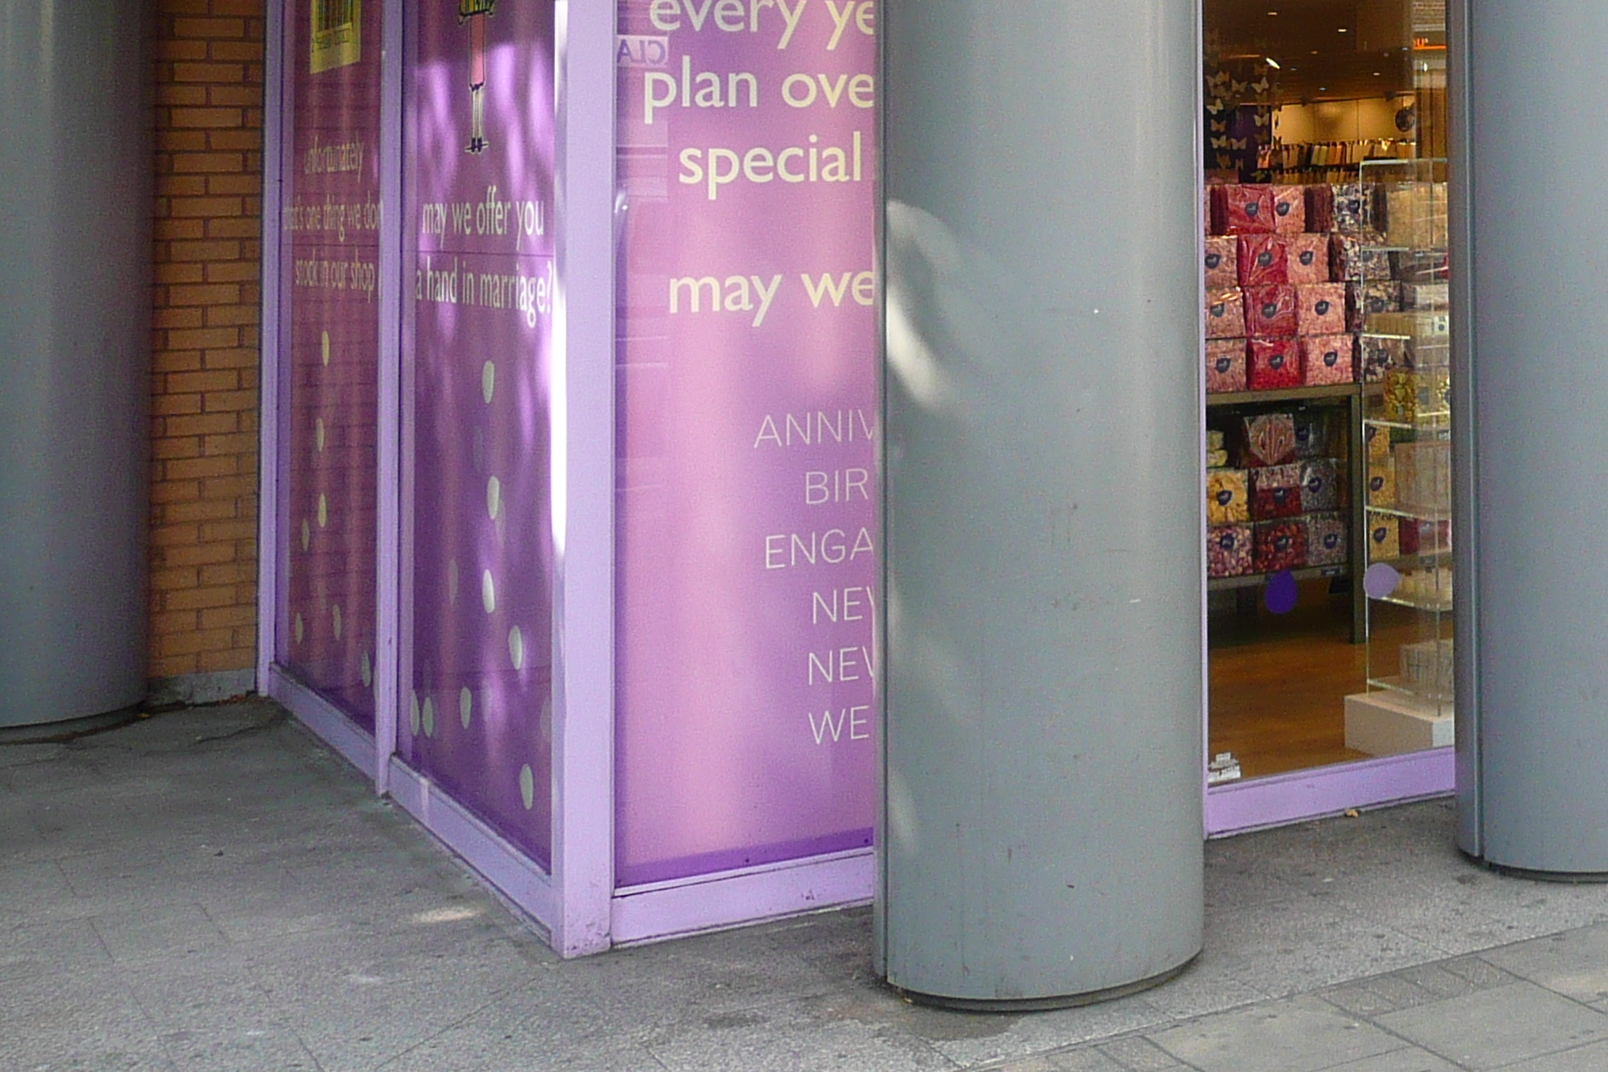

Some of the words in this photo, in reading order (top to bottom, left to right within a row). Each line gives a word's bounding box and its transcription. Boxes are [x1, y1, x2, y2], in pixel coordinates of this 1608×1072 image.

[644, 55, 757, 124] plan
[303, 129, 365, 183] unfortunately
[679, 131, 861, 200] special
[305, 204, 321, 230] one
[323, 192, 345, 242] thing
[422, 201, 448, 249] may
[453, 201, 471, 235] we
[476, 185, 512, 236] offer
[517, 199, 545, 251] you
[295, 248, 318, 286] stock
[331, 260, 349, 288] our
[350, 247, 376, 304] shop
[416, 268, 422, 300] a
[427, 256, 457, 303] hand
[463, 262, 474, 306] in
[481, 260, 554, 328] marriage?
[669, 274, 782, 327] may
[801, 271, 874, 308] we
[806, 468, 869, 505] BIR
[808, 705, 870, 745] WE
